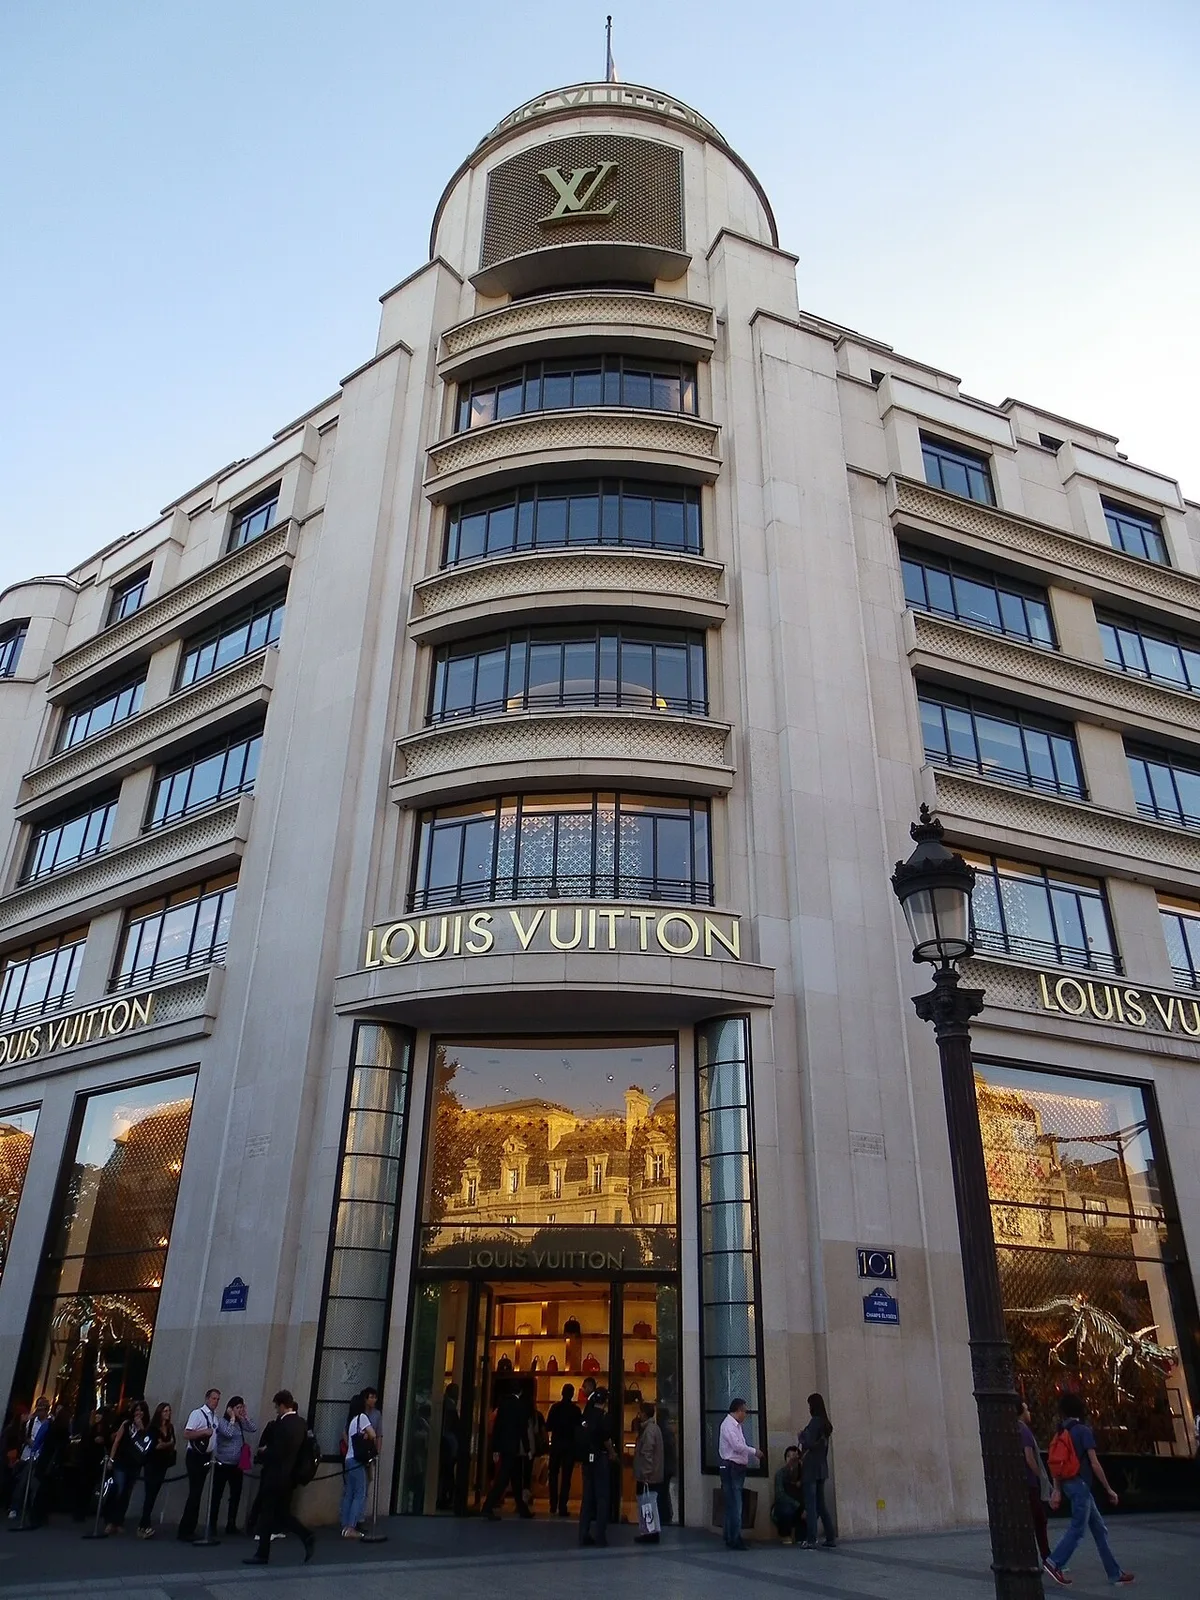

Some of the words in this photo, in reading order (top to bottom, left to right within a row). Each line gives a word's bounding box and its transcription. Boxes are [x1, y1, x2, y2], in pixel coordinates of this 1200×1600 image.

[366, 912, 494, 968] LOUIS
[509, 909, 741, 961] VUITTON
[48, 993, 154, 1052] VUITTON
[1039, 974, 1147, 1026] LOUIS
[468, 1249, 527, 1268] LOUIS
[532, 1249, 624, 1270] VUITTON
[859, 1251, 894, 1277] 101
